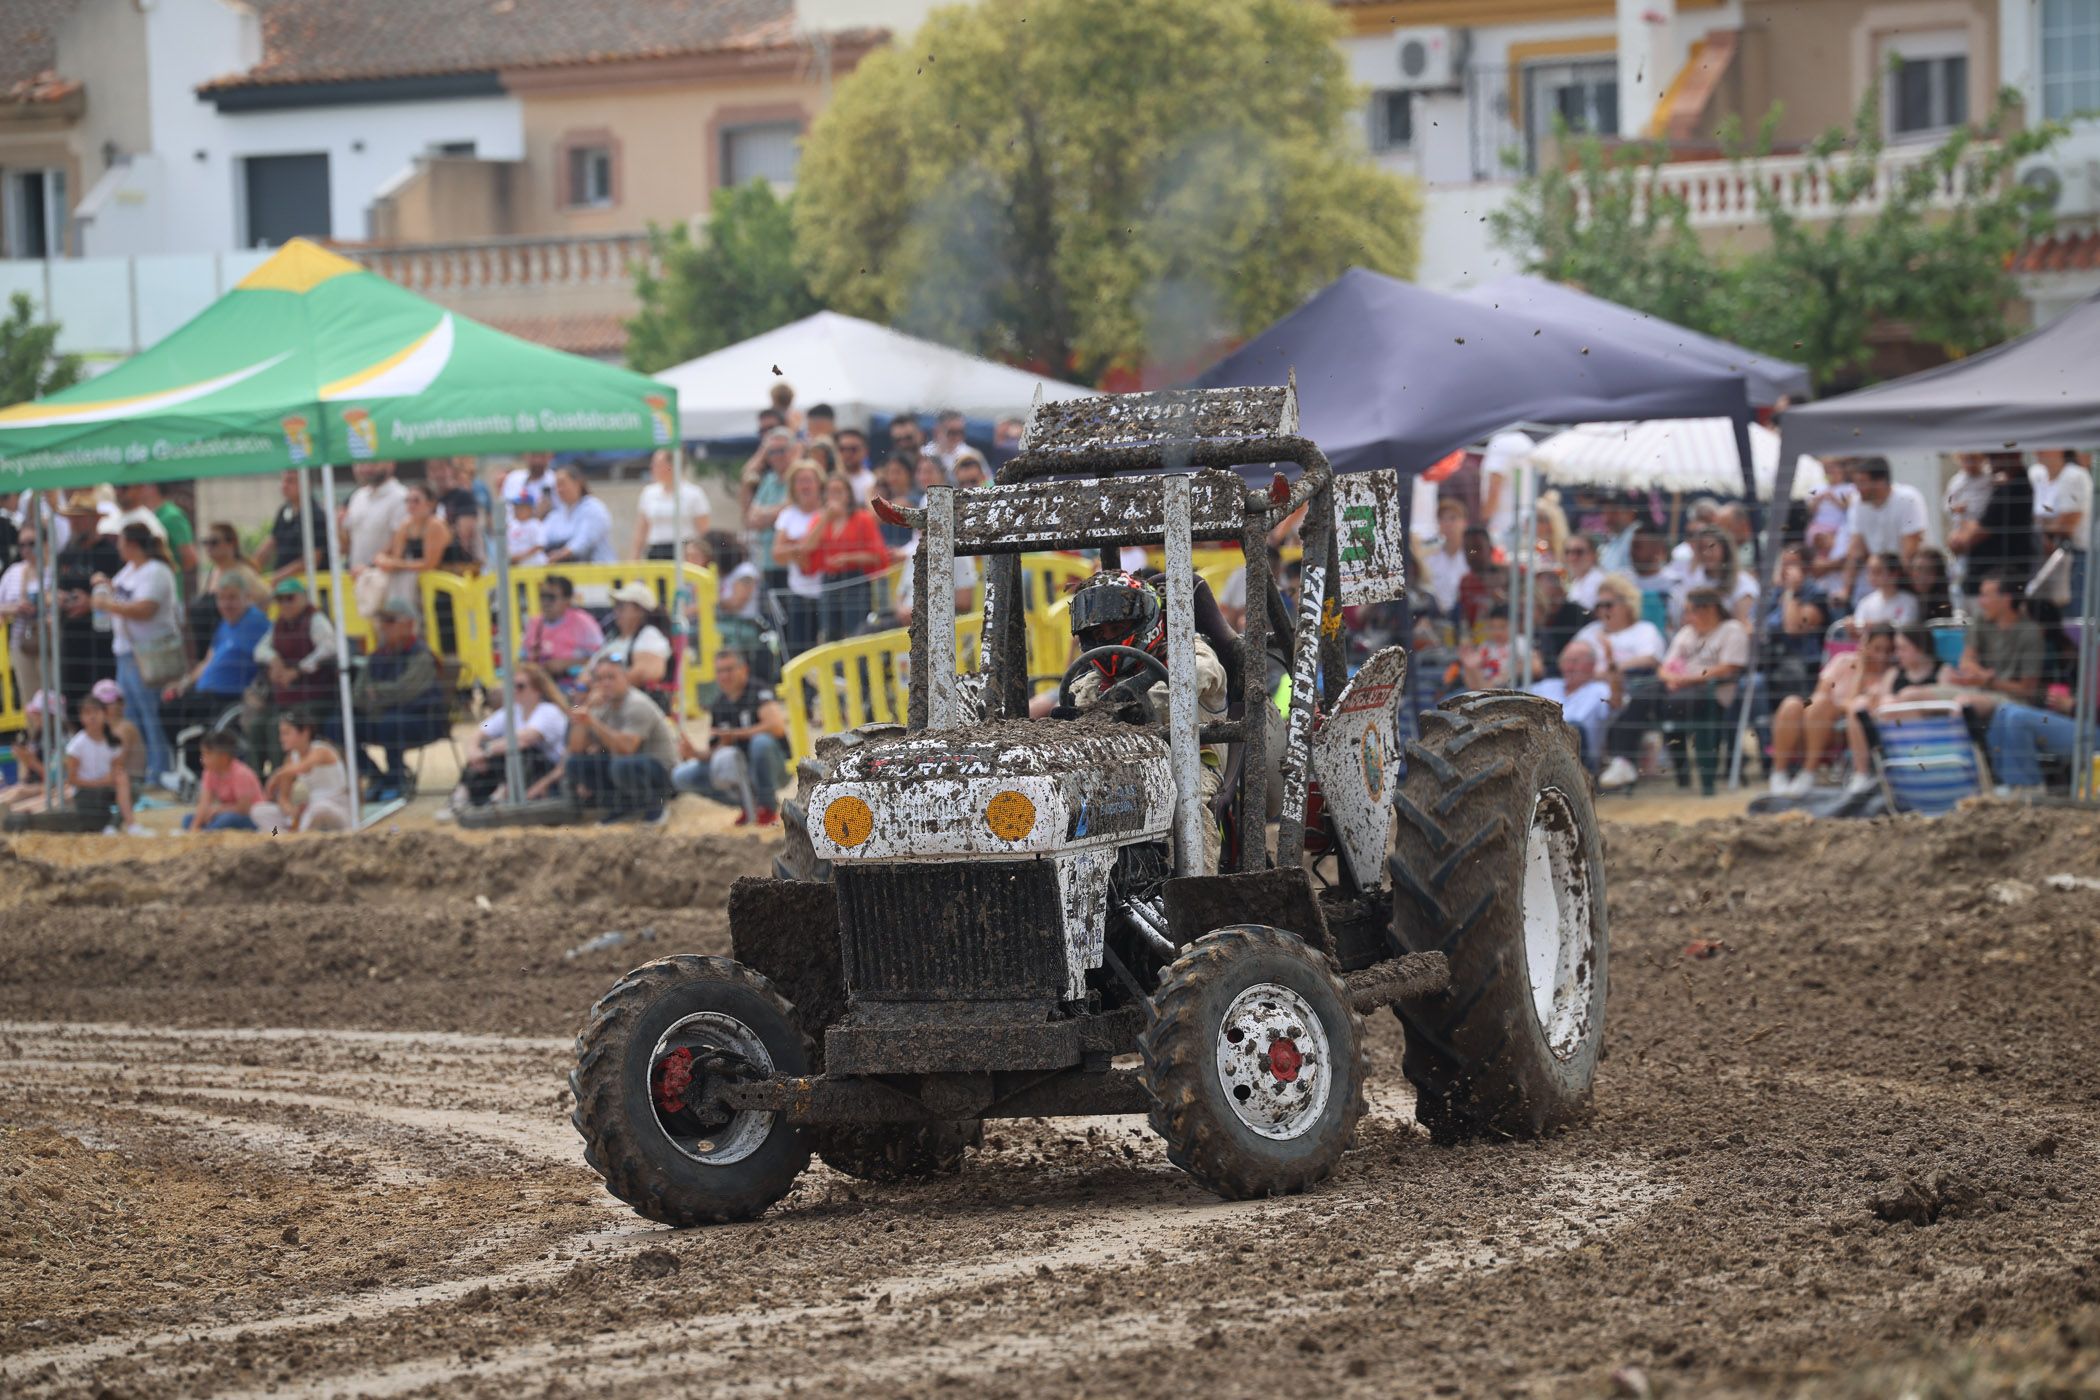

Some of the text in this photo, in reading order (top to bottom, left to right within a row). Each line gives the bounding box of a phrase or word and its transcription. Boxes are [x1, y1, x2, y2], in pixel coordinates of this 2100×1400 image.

[391, 415, 512, 446] Ayuntamiento
[516, 411, 538, 433] de
[124, 441, 149, 464] de
